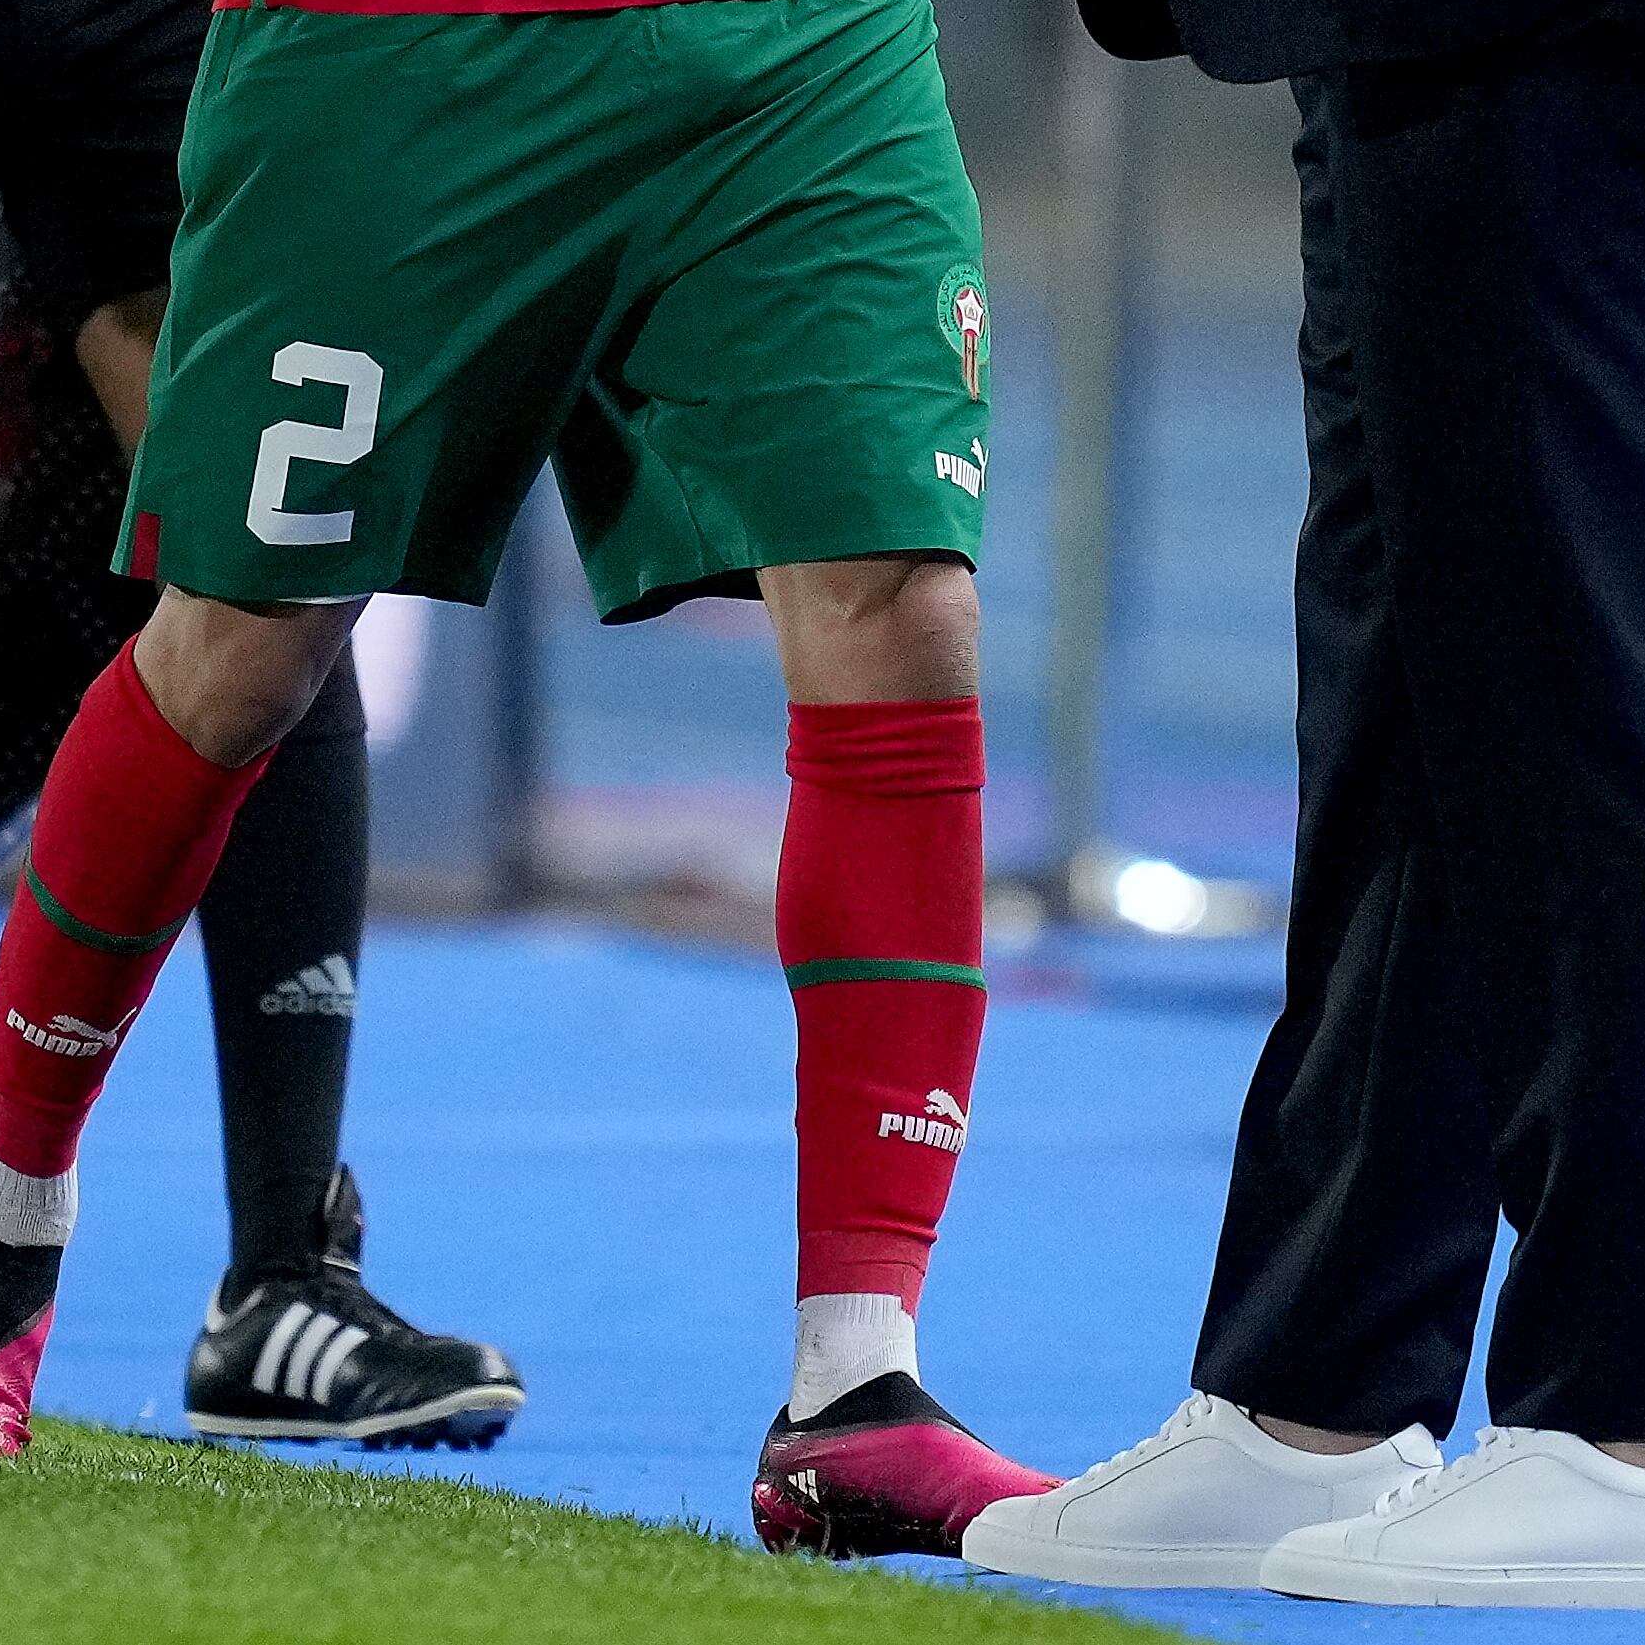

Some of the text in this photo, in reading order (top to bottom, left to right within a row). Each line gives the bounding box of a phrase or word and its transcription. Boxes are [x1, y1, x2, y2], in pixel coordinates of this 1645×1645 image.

[246, 341, 384, 545] 2
[934, 451, 981, 499] PUMA
[6, 1007, 104, 1057] PUMA
